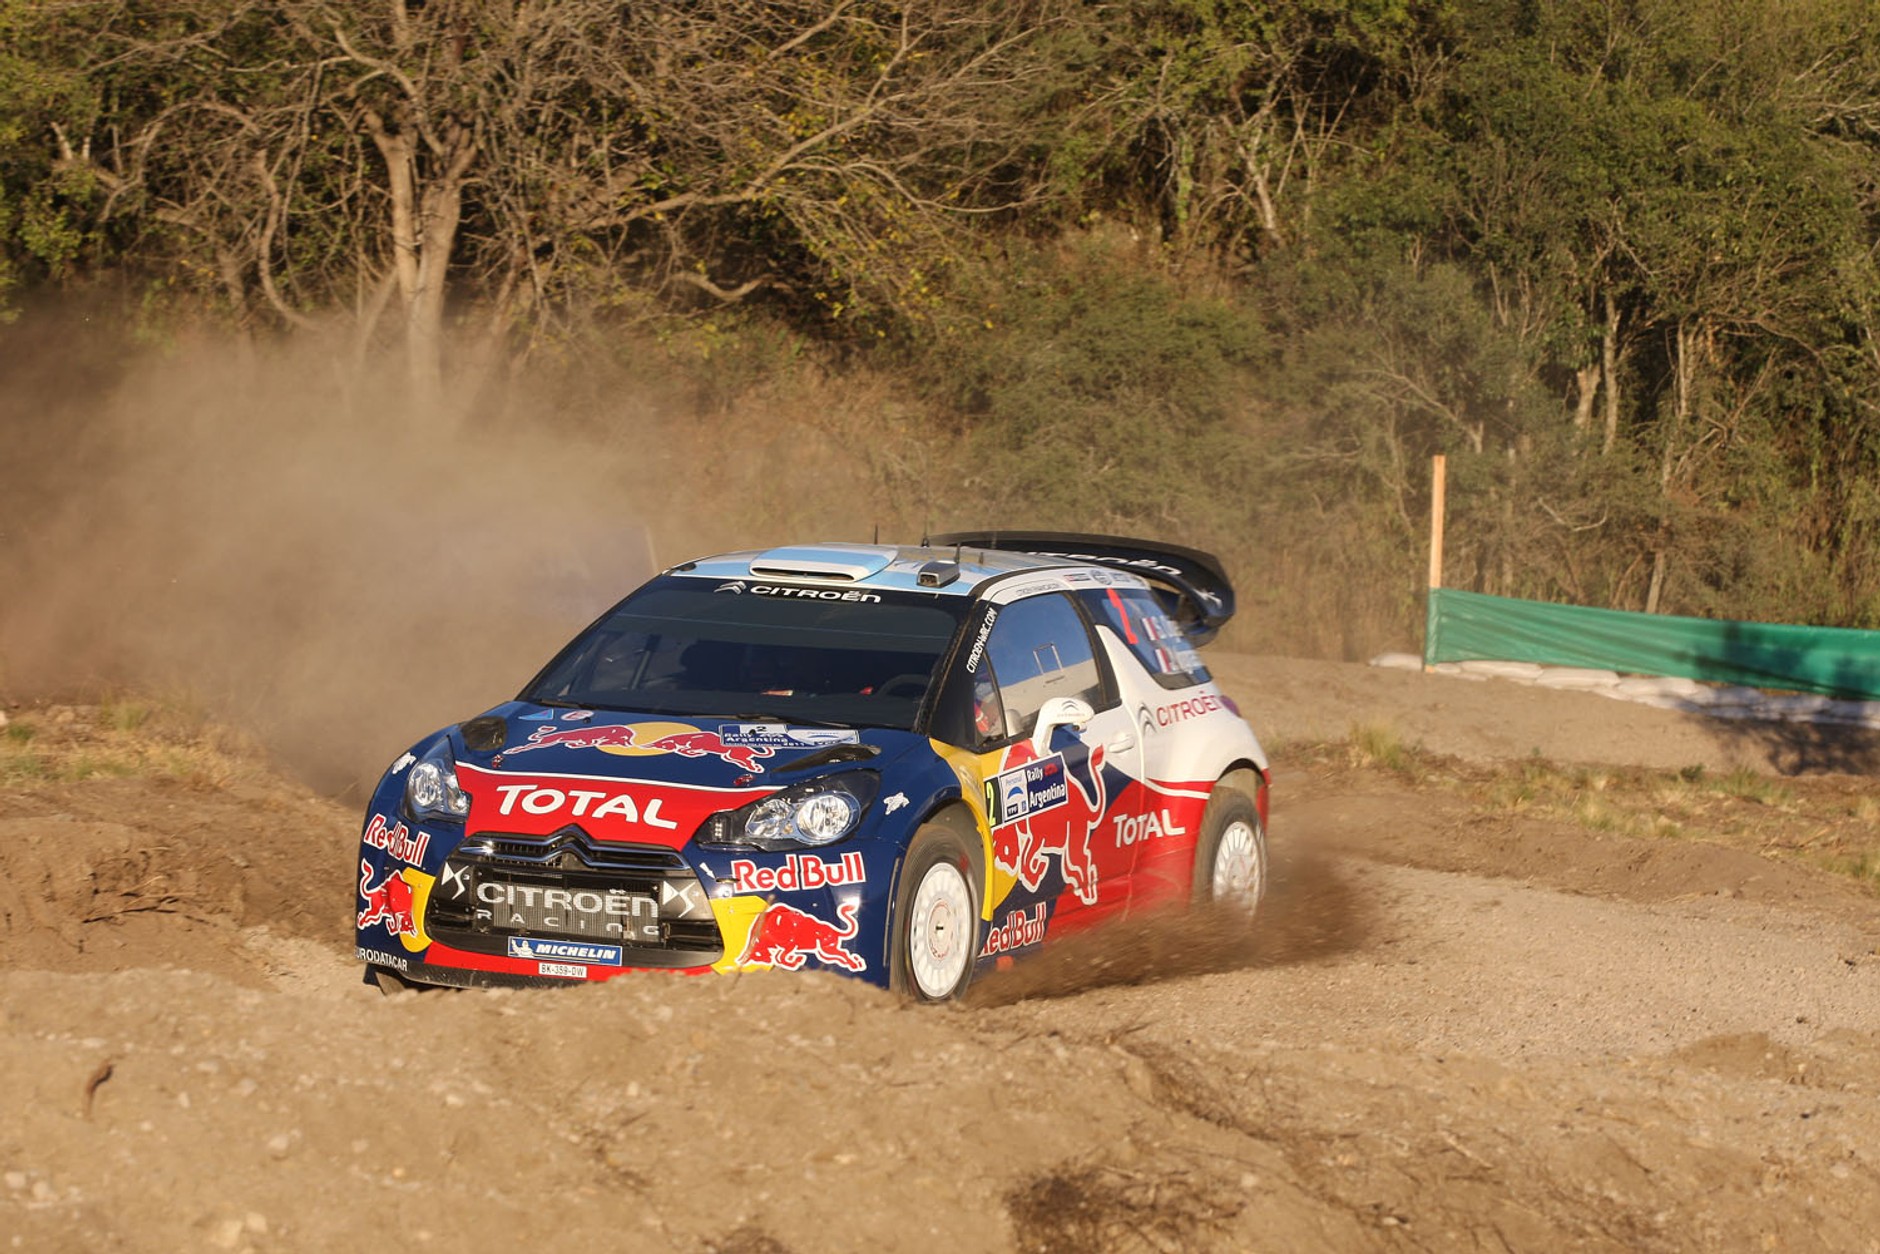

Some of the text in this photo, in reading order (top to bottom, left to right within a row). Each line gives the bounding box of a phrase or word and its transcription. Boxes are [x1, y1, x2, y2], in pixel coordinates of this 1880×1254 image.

[1026, 767, 1044, 782] Rally
[496, 784, 678, 830] TOTAL
[986, 781, 996, 826] 2
[1029, 783, 1066, 808] Argentina
[1113, 809, 1186, 848] TOTAL
[536, 943, 617, 960] MICHELIN
[979, 911, 1012, 956] ed
